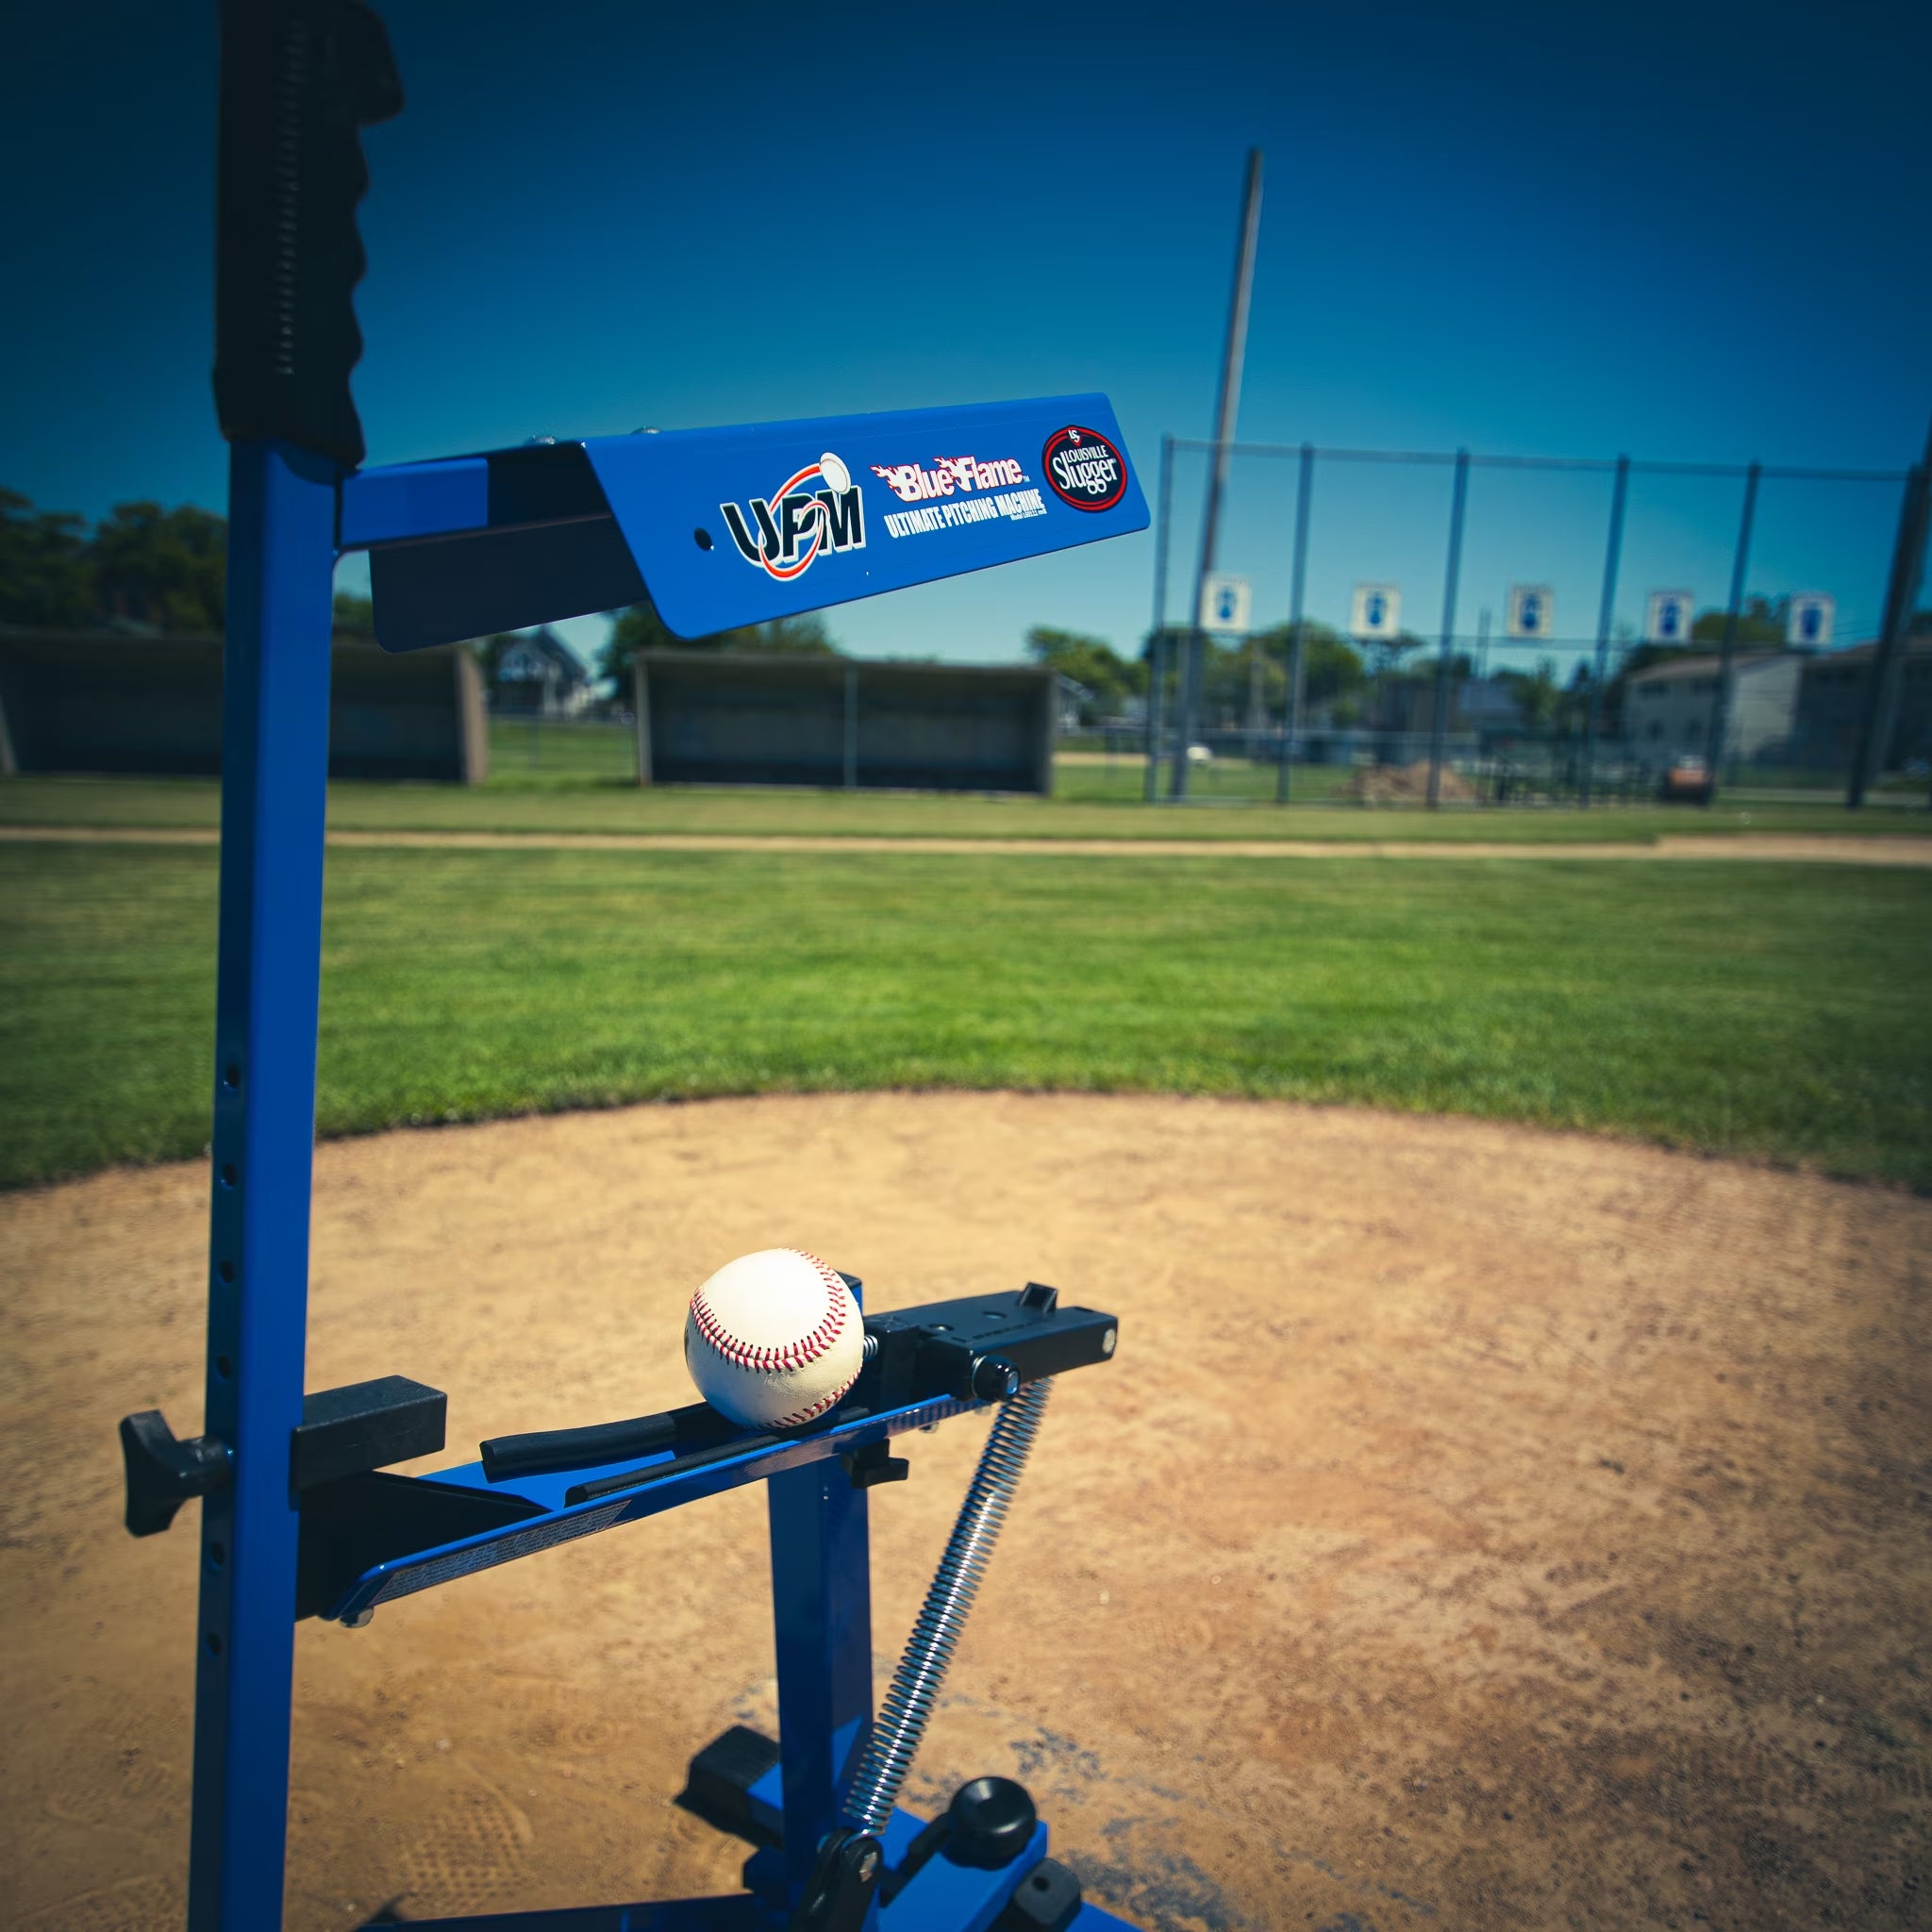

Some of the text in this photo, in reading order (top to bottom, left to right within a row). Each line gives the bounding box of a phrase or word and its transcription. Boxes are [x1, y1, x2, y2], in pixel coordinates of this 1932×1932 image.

[1053, 452, 1117, 494] Slugger
[1064, 445, 1109, 462] LOUISVILLE
[870, 464, 955, 502] Blue
[720, 485, 866, 571] UPM
[883, 506, 946, 539] ULTIMATE
[941, 497, 998, 526] PITCHING
[994, 489, 1044, 517] MACHINE
